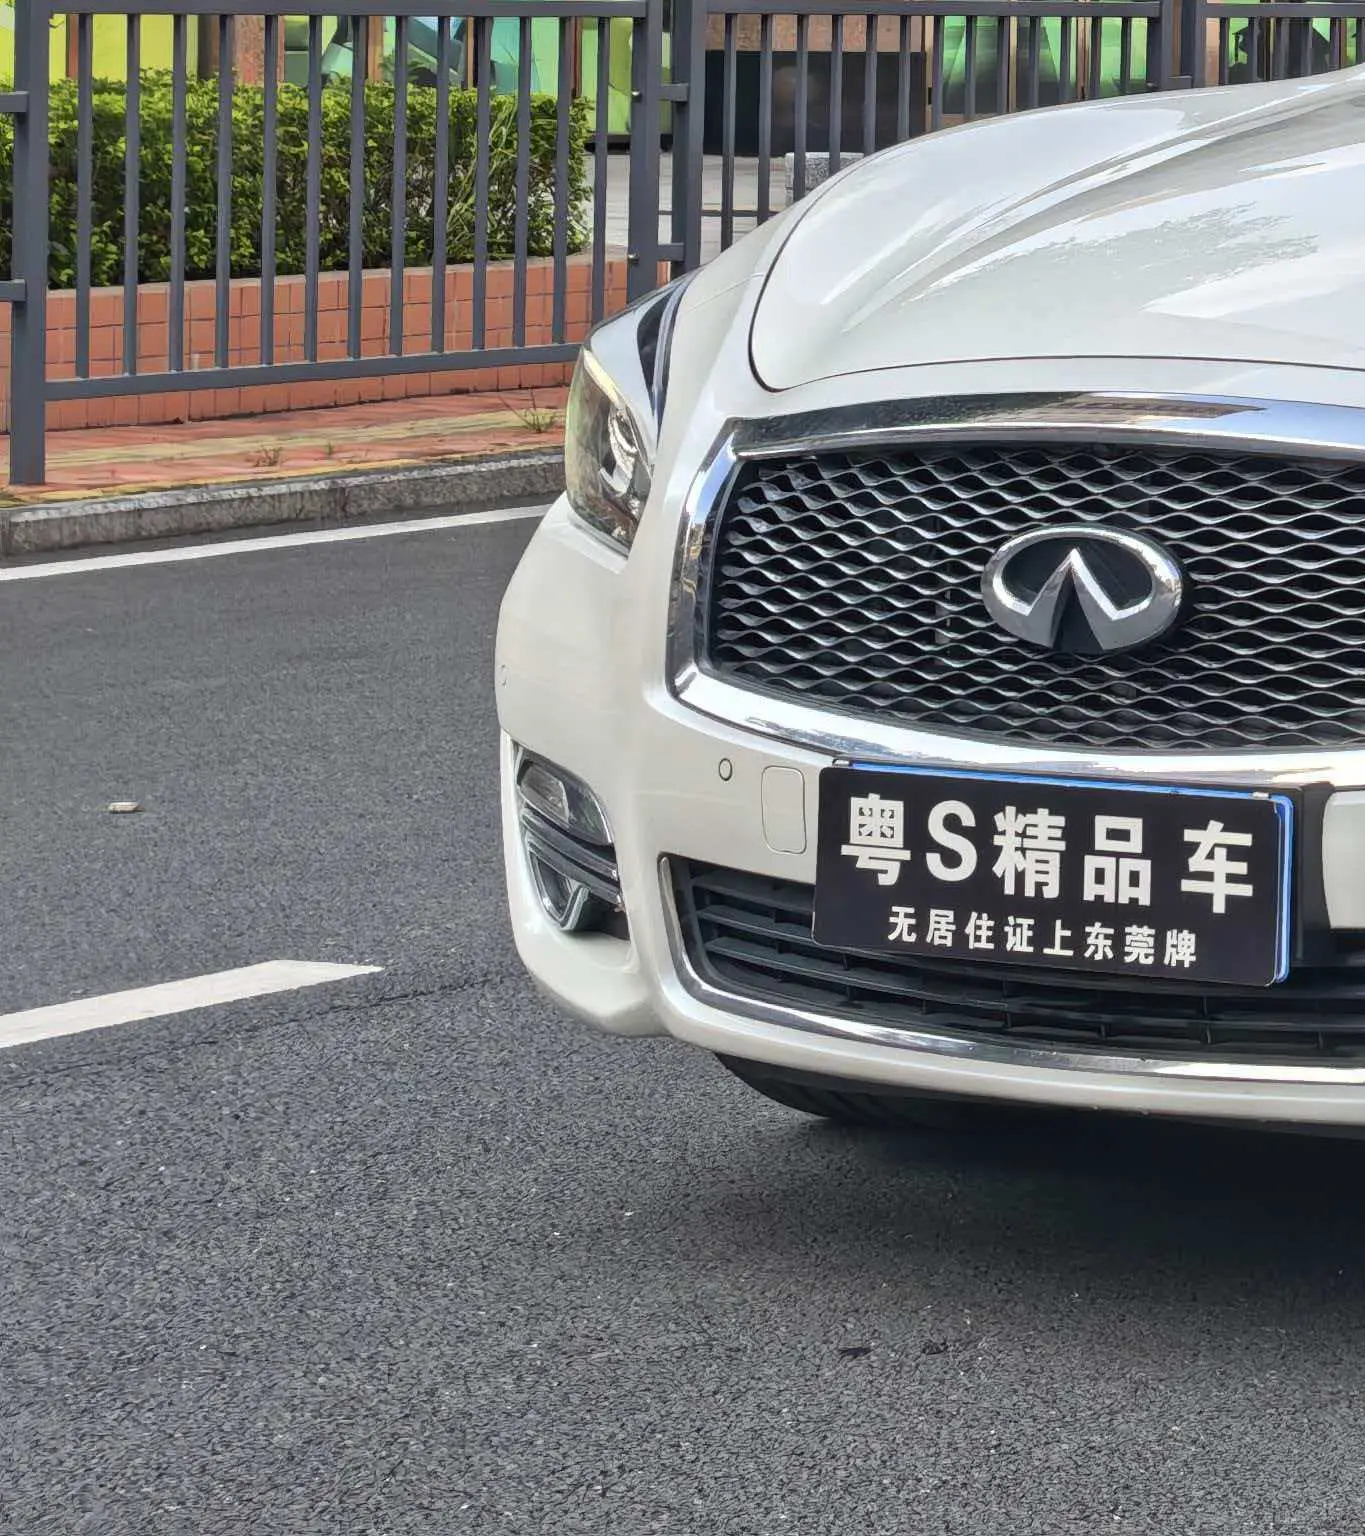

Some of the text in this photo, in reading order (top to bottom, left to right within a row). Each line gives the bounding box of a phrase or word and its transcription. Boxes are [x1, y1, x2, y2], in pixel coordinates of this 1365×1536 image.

[840, 793, 1255, 914] 粤S精品车
[887, 905, 1198, 968] 无居住证上东莞牌
